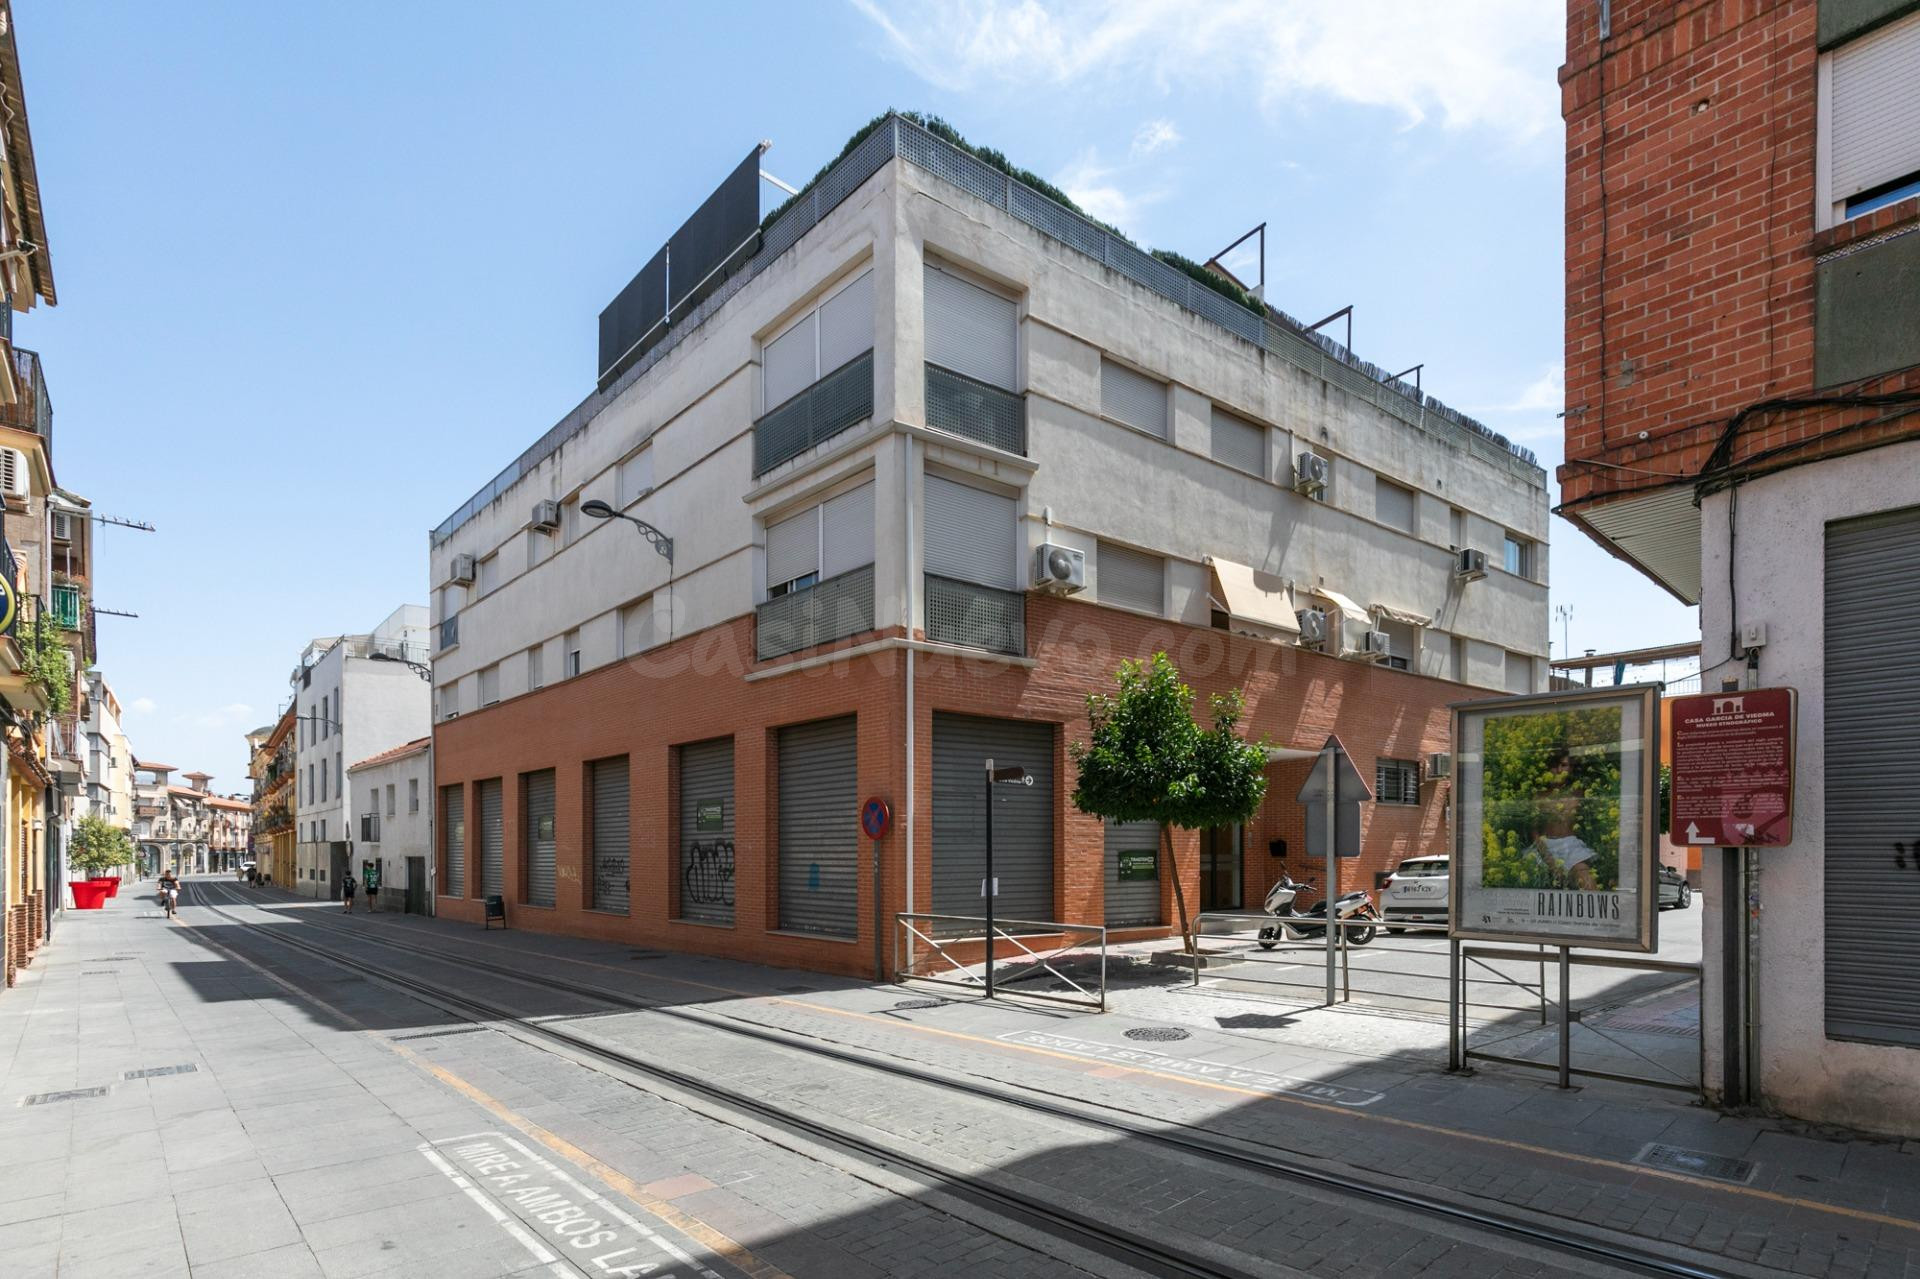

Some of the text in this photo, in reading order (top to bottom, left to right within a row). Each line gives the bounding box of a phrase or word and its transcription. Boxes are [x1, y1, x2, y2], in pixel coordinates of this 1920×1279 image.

[1537, 892, 1620, 920] RAINBOWS
[456, 1142, 676, 1279] MIRE A AMBOS LA
